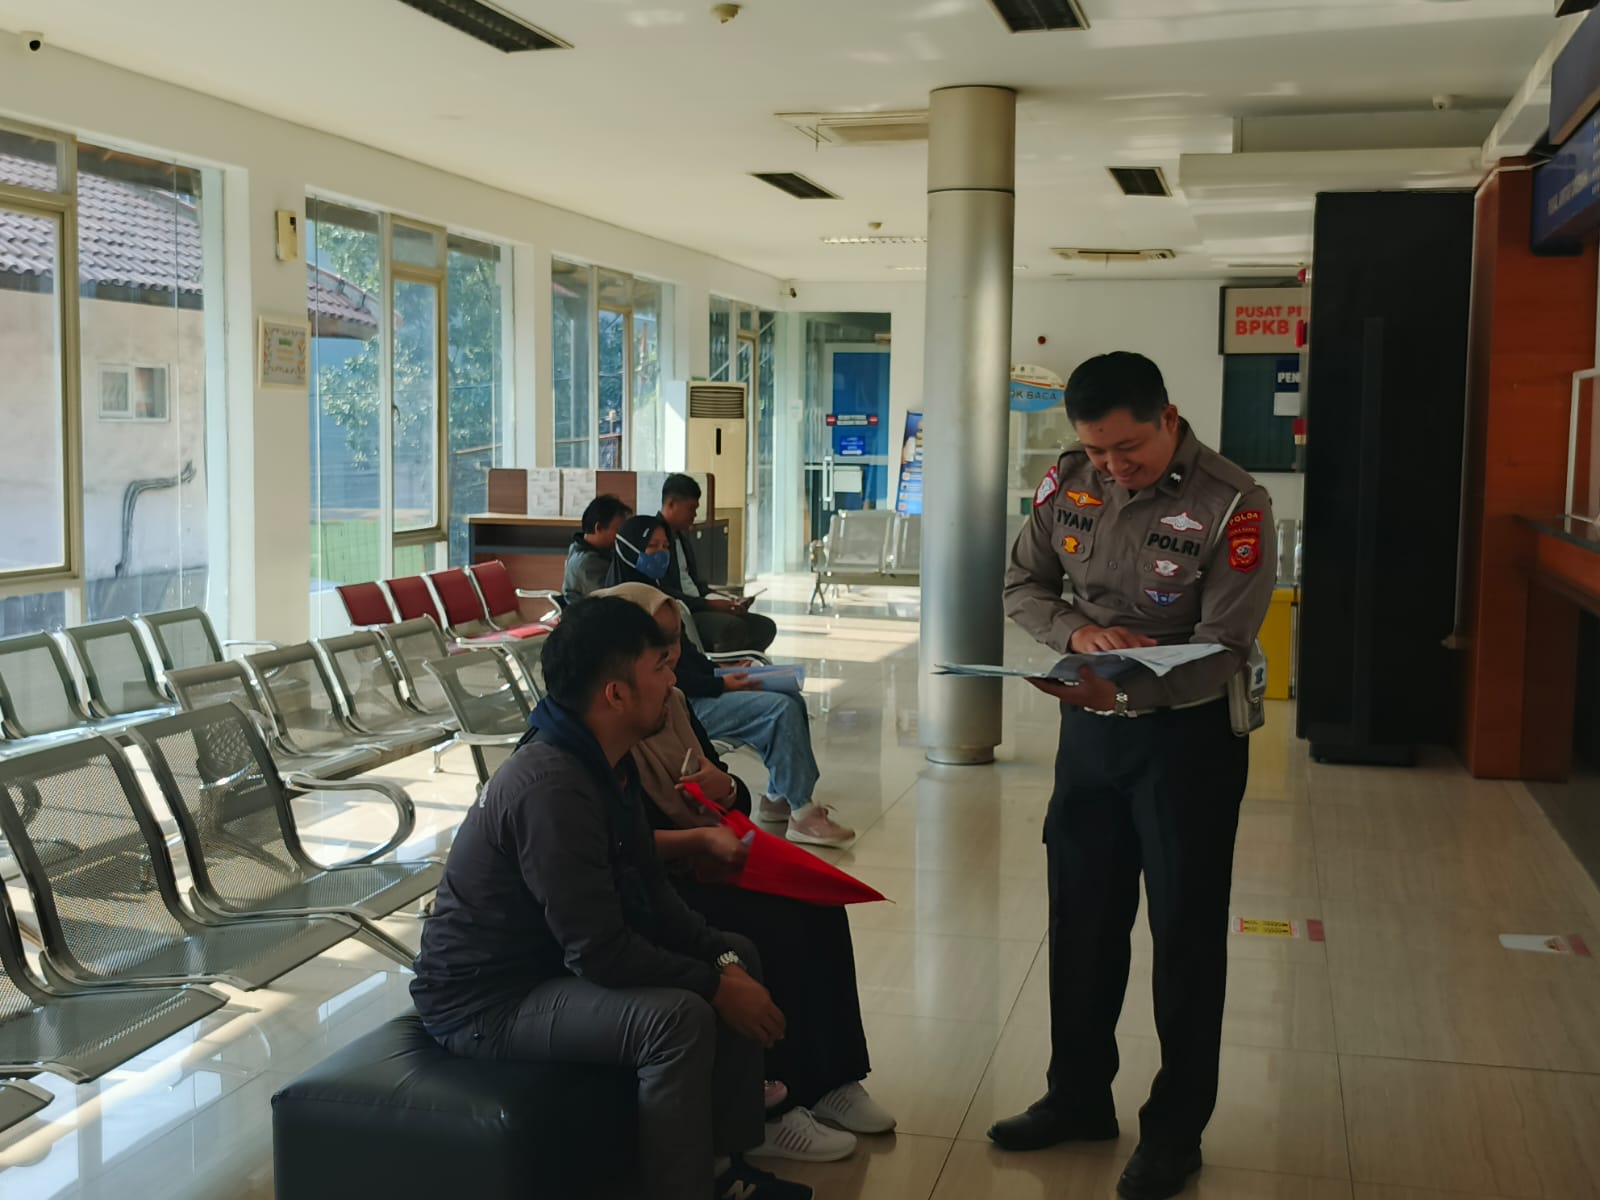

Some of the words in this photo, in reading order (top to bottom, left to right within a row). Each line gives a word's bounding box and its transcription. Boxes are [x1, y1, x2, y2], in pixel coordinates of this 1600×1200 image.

[1235, 306, 1282, 318] PUSAT
[1235, 320, 1289, 335] BPKB
[1057, 509, 1094, 532] IYAN
[1229, 512, 1259, 526] POLDA
[1147, 532, 1201, 557] POLRI
